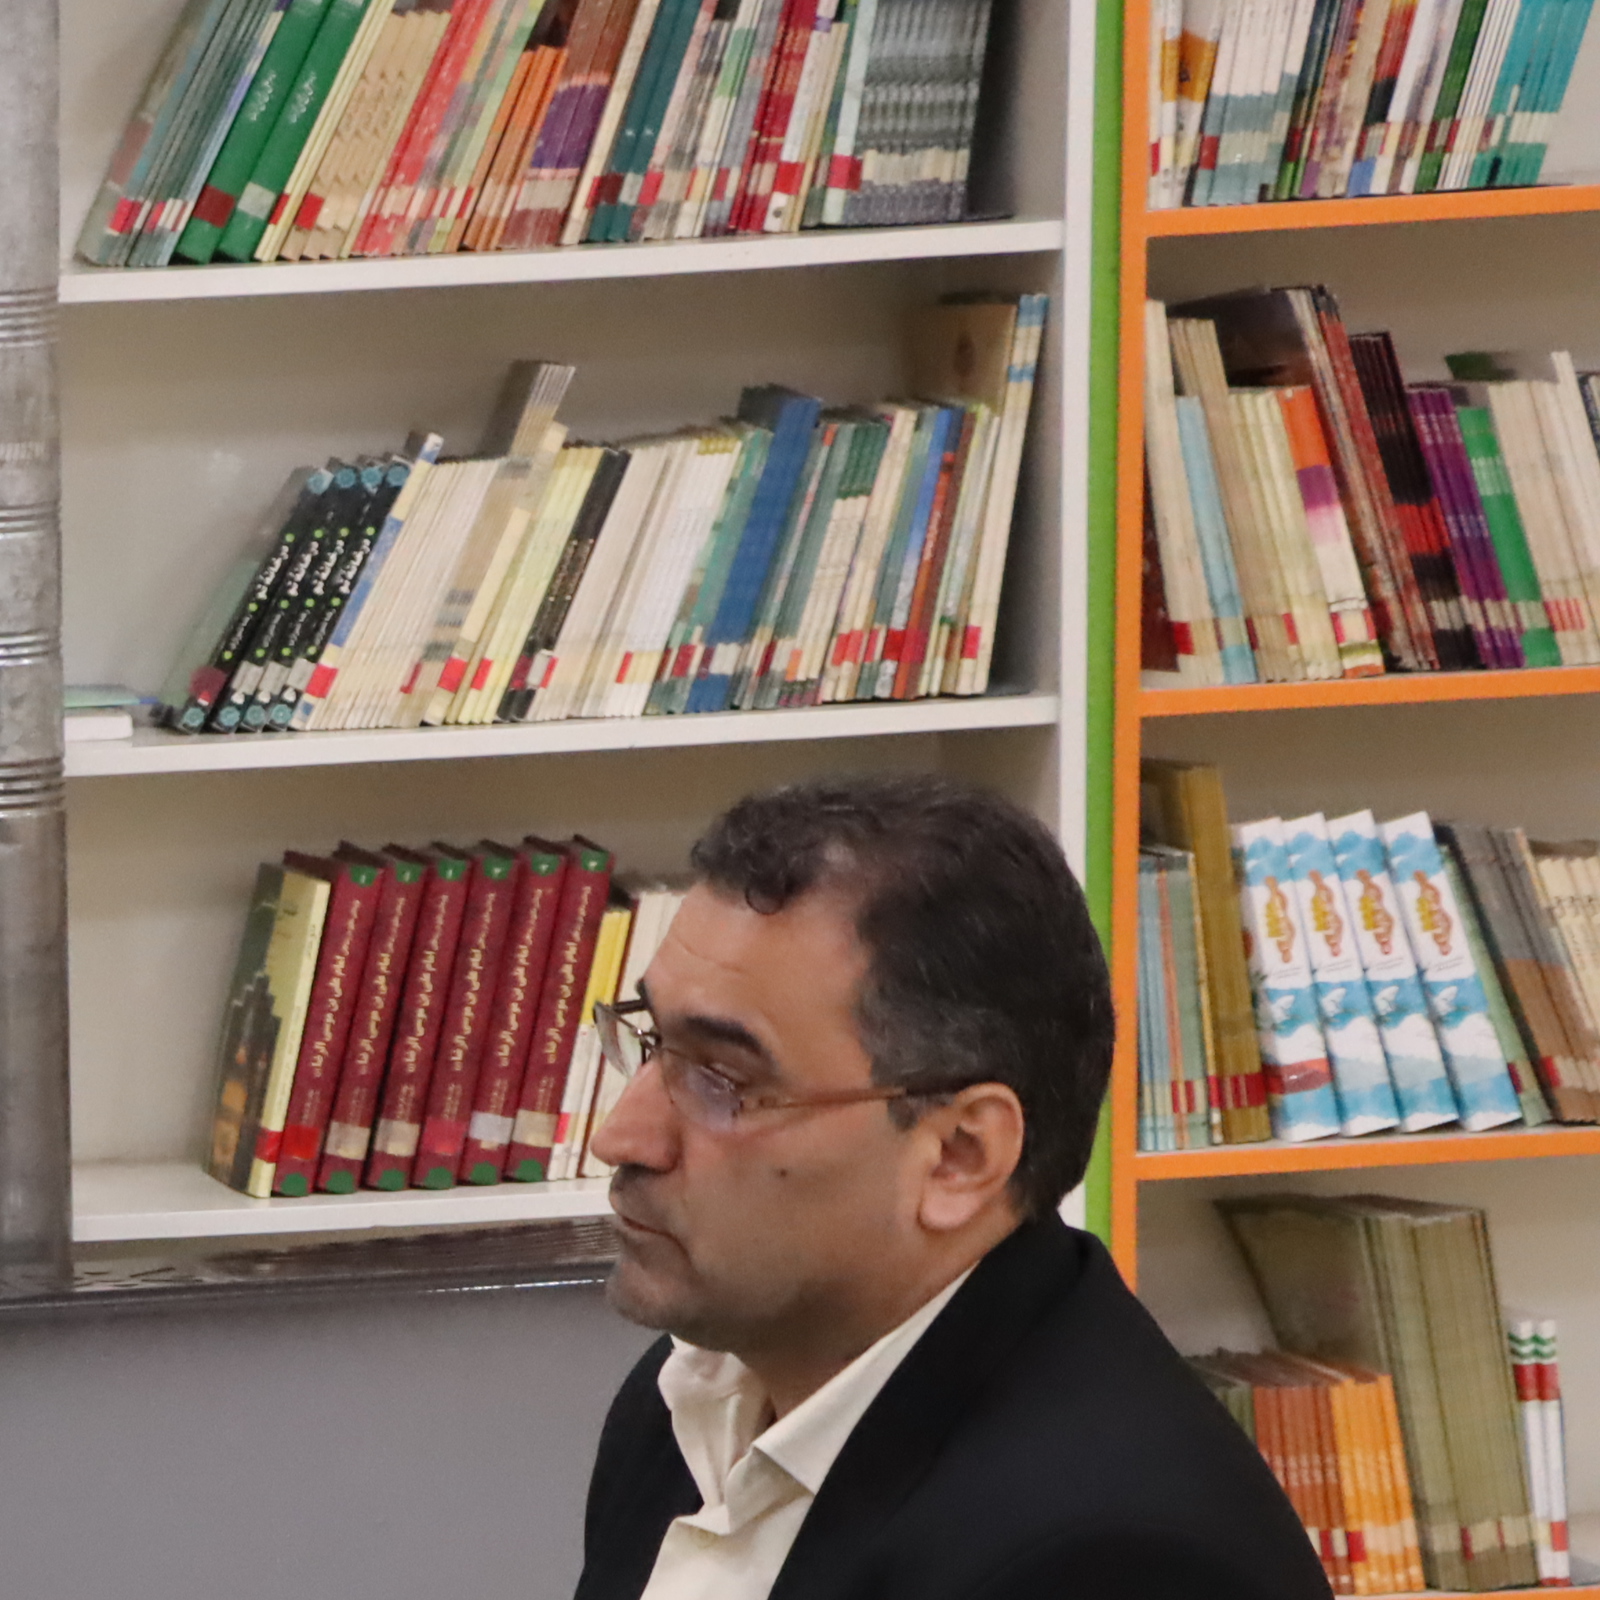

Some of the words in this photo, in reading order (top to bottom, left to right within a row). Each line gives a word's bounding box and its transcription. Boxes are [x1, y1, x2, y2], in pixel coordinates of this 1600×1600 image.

[422, 950, 437, 972] امام
[469, 948, 484, 971] امام
[516, 944, 530, 966] امام
[564, 941, 578, 963] امام
[331, 955, 346, 977] امام
[377, 952, 392, 975] امام
